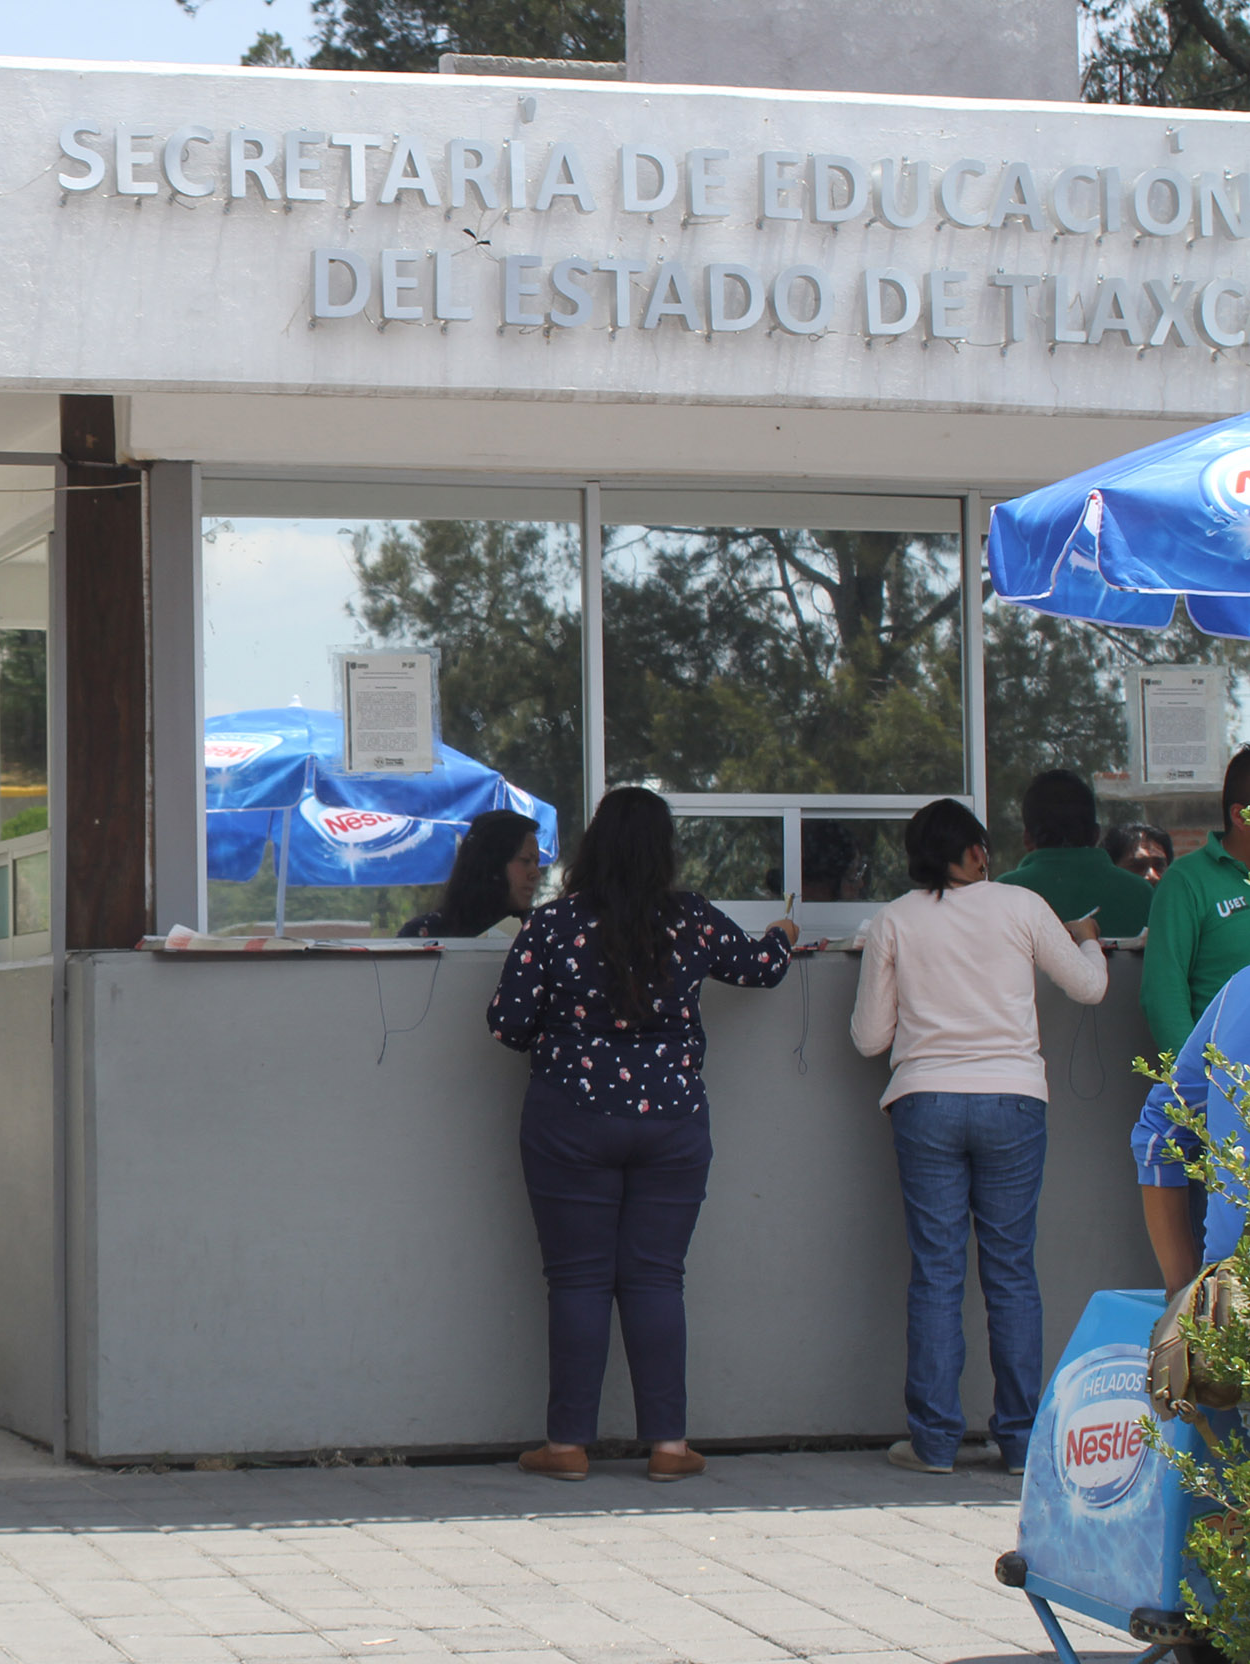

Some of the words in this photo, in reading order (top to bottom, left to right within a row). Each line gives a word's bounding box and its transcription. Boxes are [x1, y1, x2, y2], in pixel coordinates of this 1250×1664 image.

[57, 95, 596, 213] SECRETARÍA
[617, 142, 731, 218] DE
[759, 126, 1250, 241] EDUCACIÓN
[311, 247, 474, 321] DEL
[501, 254, 834, 335] ESTADO
[864, 267, 968, 339] DE
[1083, 1372, 1144, 1398] HELADOS
